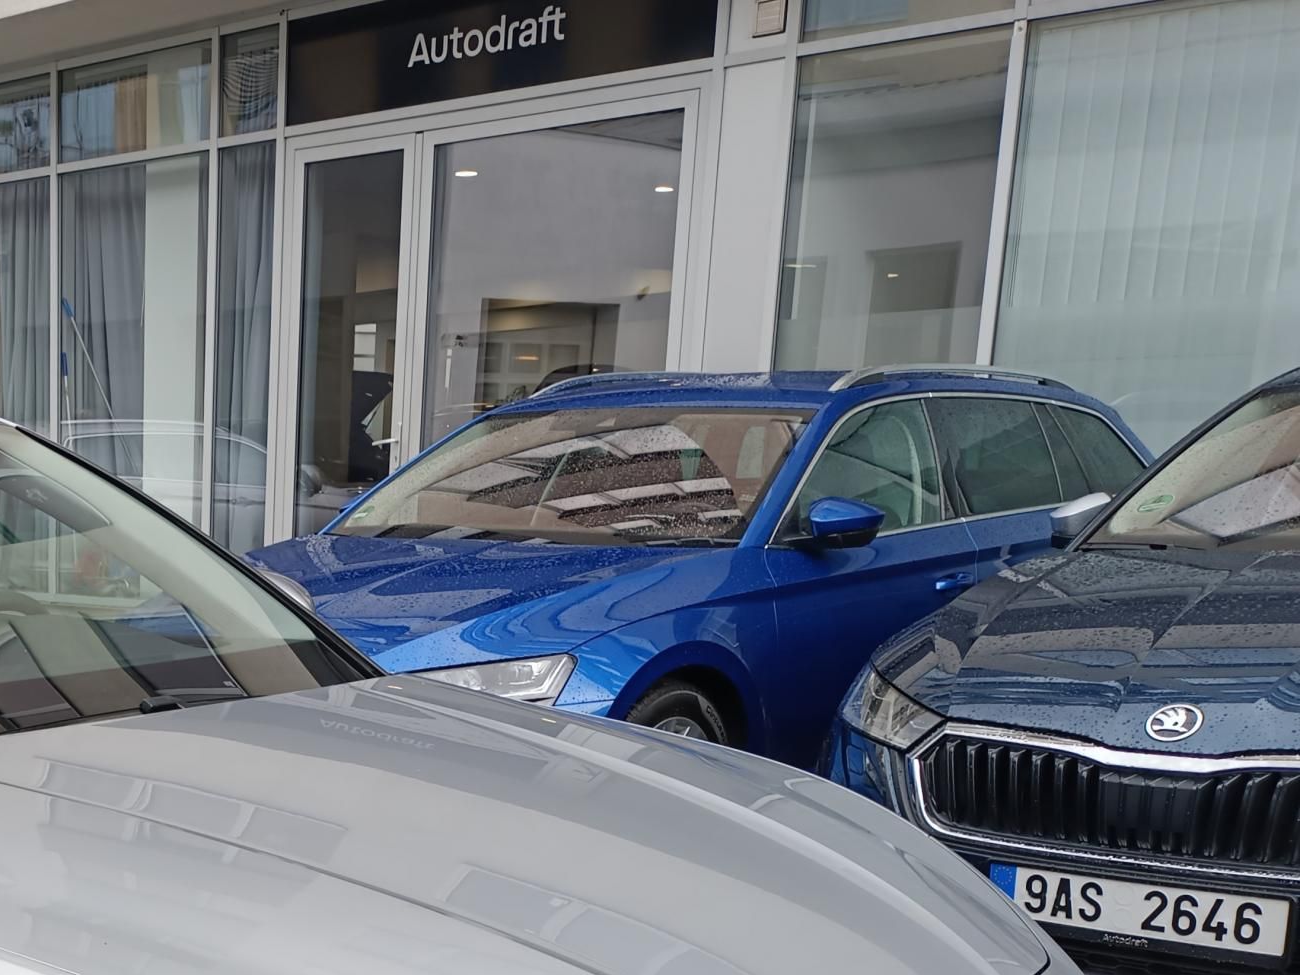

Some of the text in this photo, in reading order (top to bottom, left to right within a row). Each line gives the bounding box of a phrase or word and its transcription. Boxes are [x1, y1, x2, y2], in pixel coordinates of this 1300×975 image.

[407, 5, 566, 67] Autodraft
[1023, 874, 1263, 945] 9AS 2646
